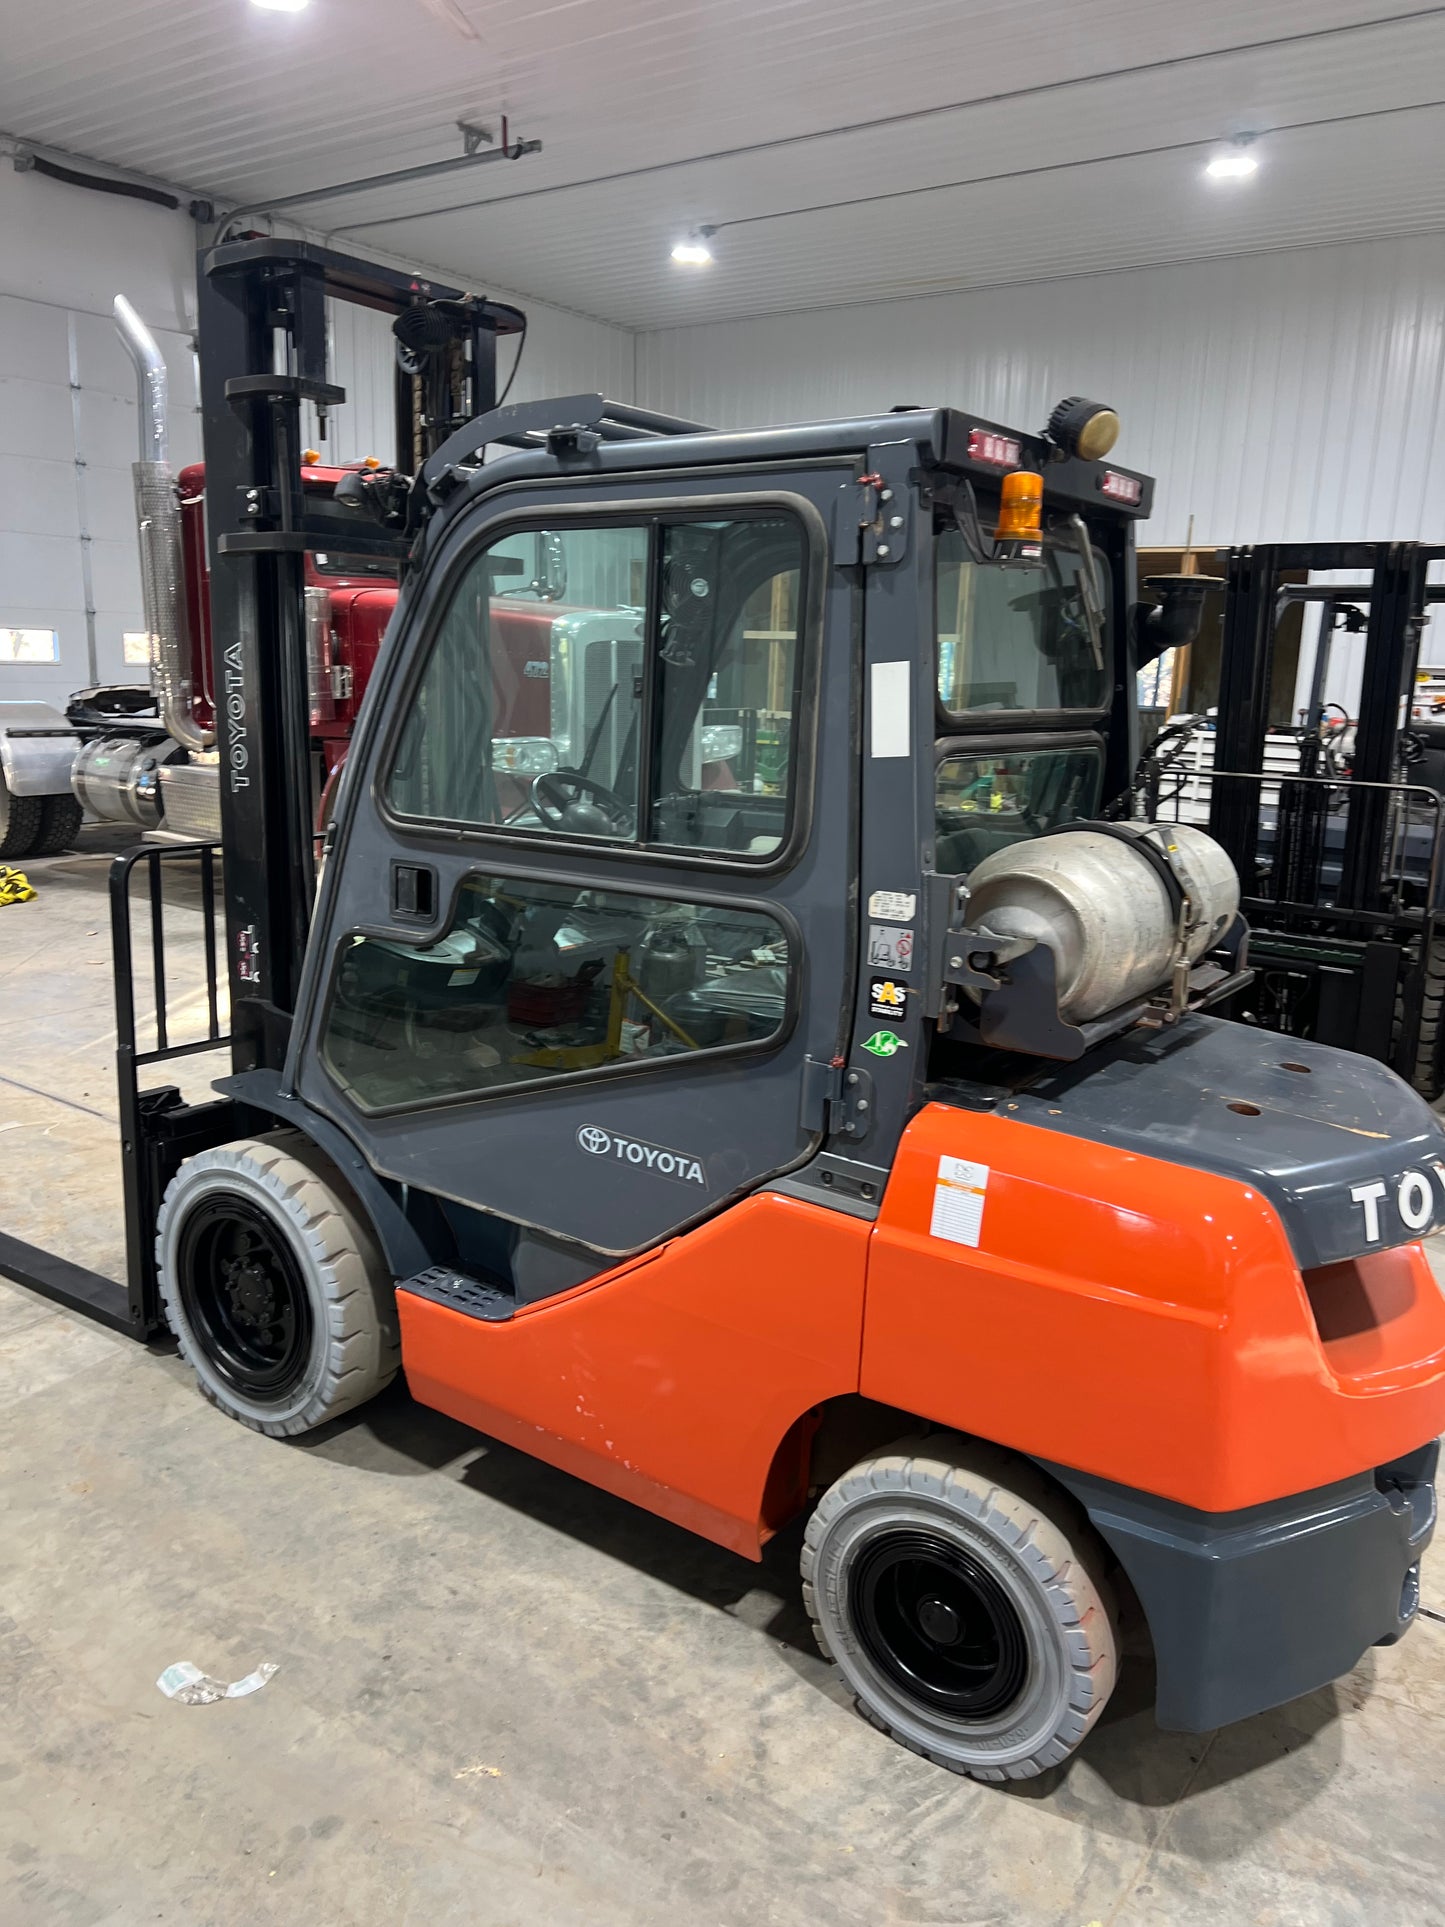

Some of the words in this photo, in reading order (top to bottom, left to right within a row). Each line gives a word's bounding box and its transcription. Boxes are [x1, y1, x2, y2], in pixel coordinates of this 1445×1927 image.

[223, 641, 250, 793] TOYOTA
[871, 981, 906, 1005] SAS
[613, 1138, 704, 1184] TOYOTA
